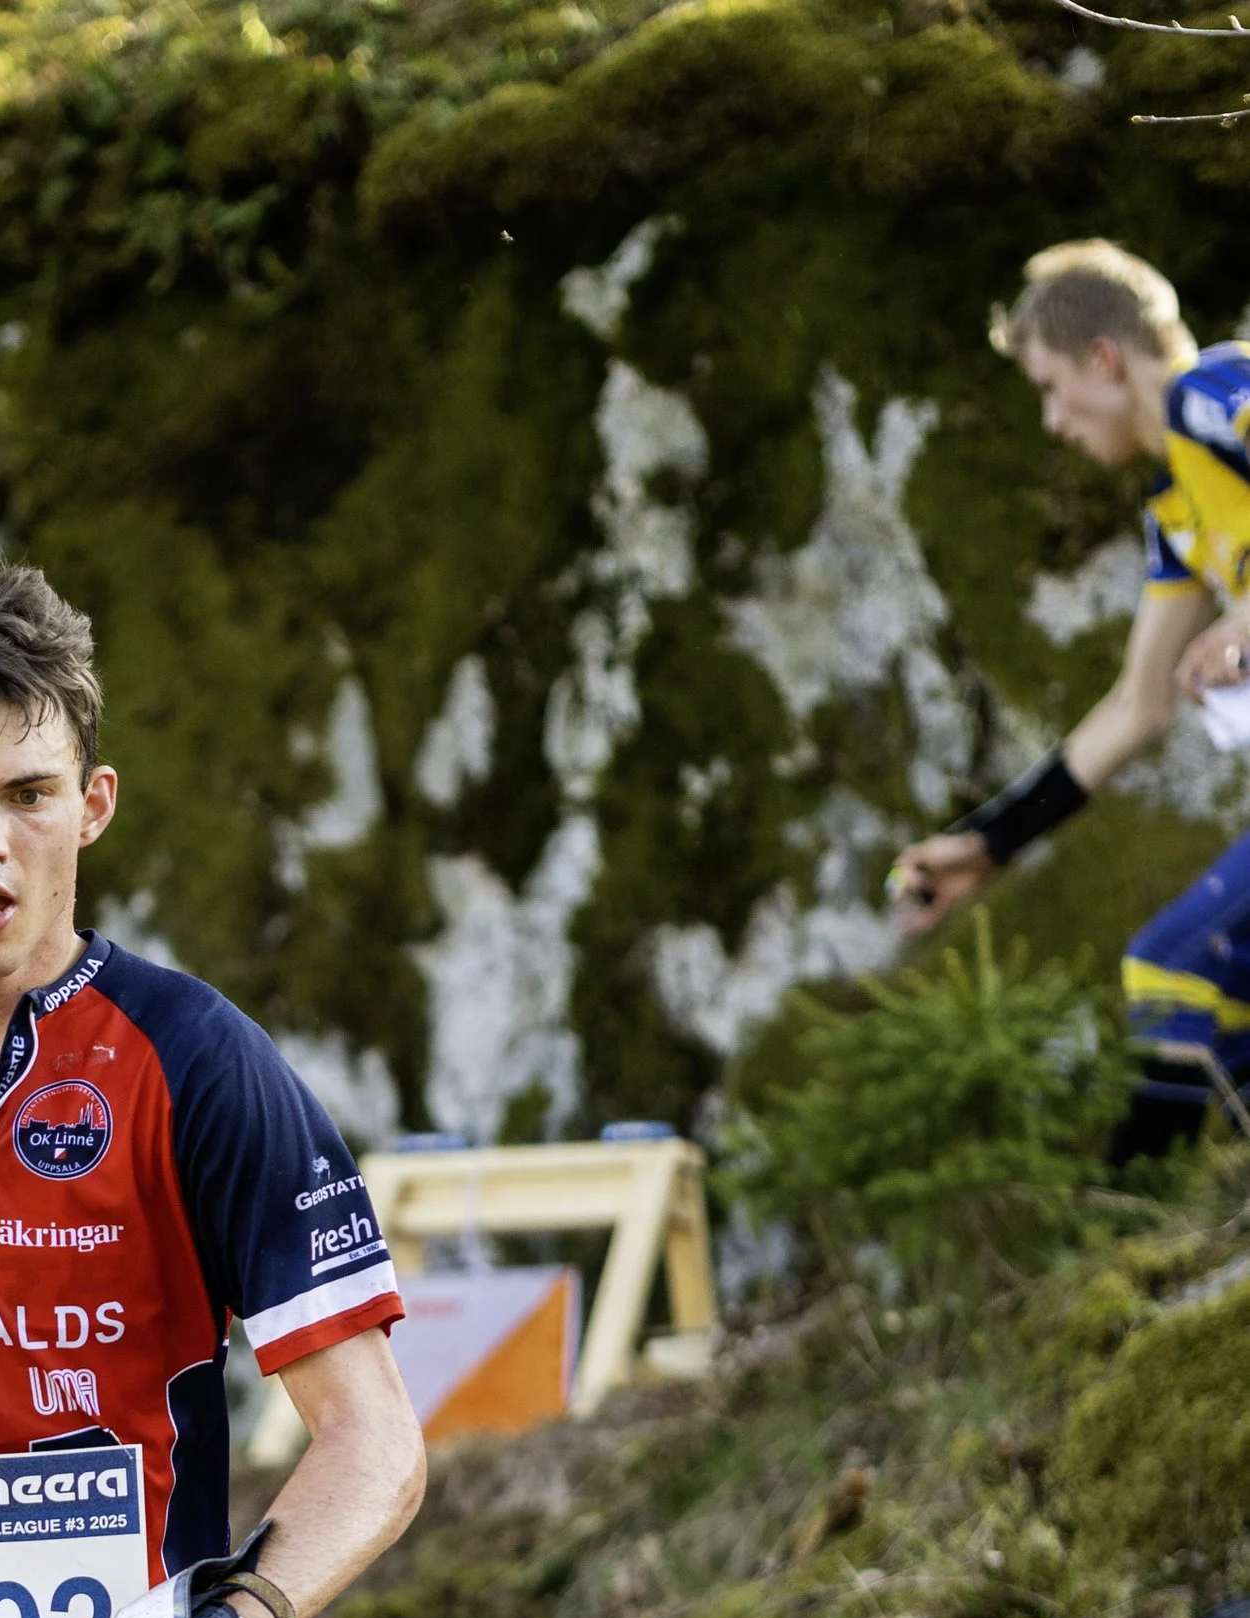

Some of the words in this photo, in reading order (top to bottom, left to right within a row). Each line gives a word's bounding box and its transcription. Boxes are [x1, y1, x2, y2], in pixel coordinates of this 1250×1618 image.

[44, 958, 103, 1012] UPPSALA
[30, 1133, 50, 1146] OK
[55, 1131, 94, 1146] Linné
[37, 1160, 81, 1173] UPPSALA
[310, 1212, 373, 1261] Fresh
[65, 1517, 85, 1532] #3
[89, 1514, 128, 1530] 2025
